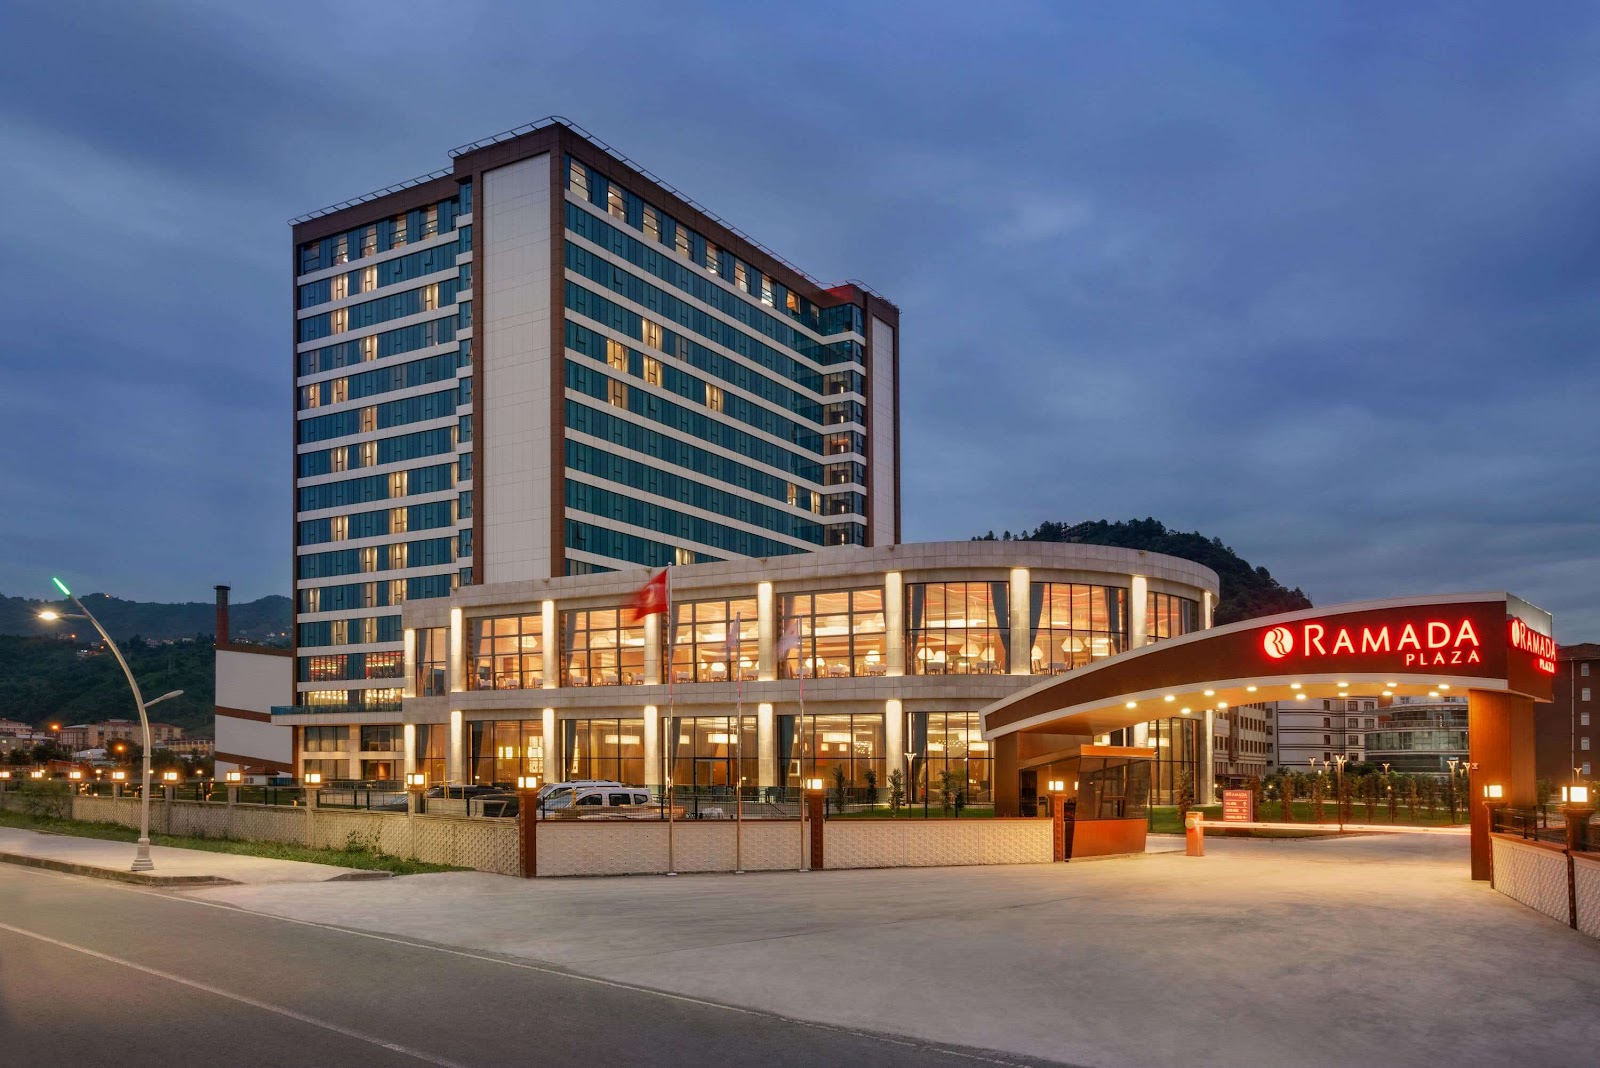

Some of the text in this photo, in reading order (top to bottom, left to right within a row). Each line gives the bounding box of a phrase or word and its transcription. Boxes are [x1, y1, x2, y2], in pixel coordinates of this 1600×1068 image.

[1304, 620, 1480, 657] RAMADA
[1520, 622, 1556, 661] RAMADA
[1406, 649, 1480, 666] PLAZA
[1539, 658, 1555, 673] PLAZA
